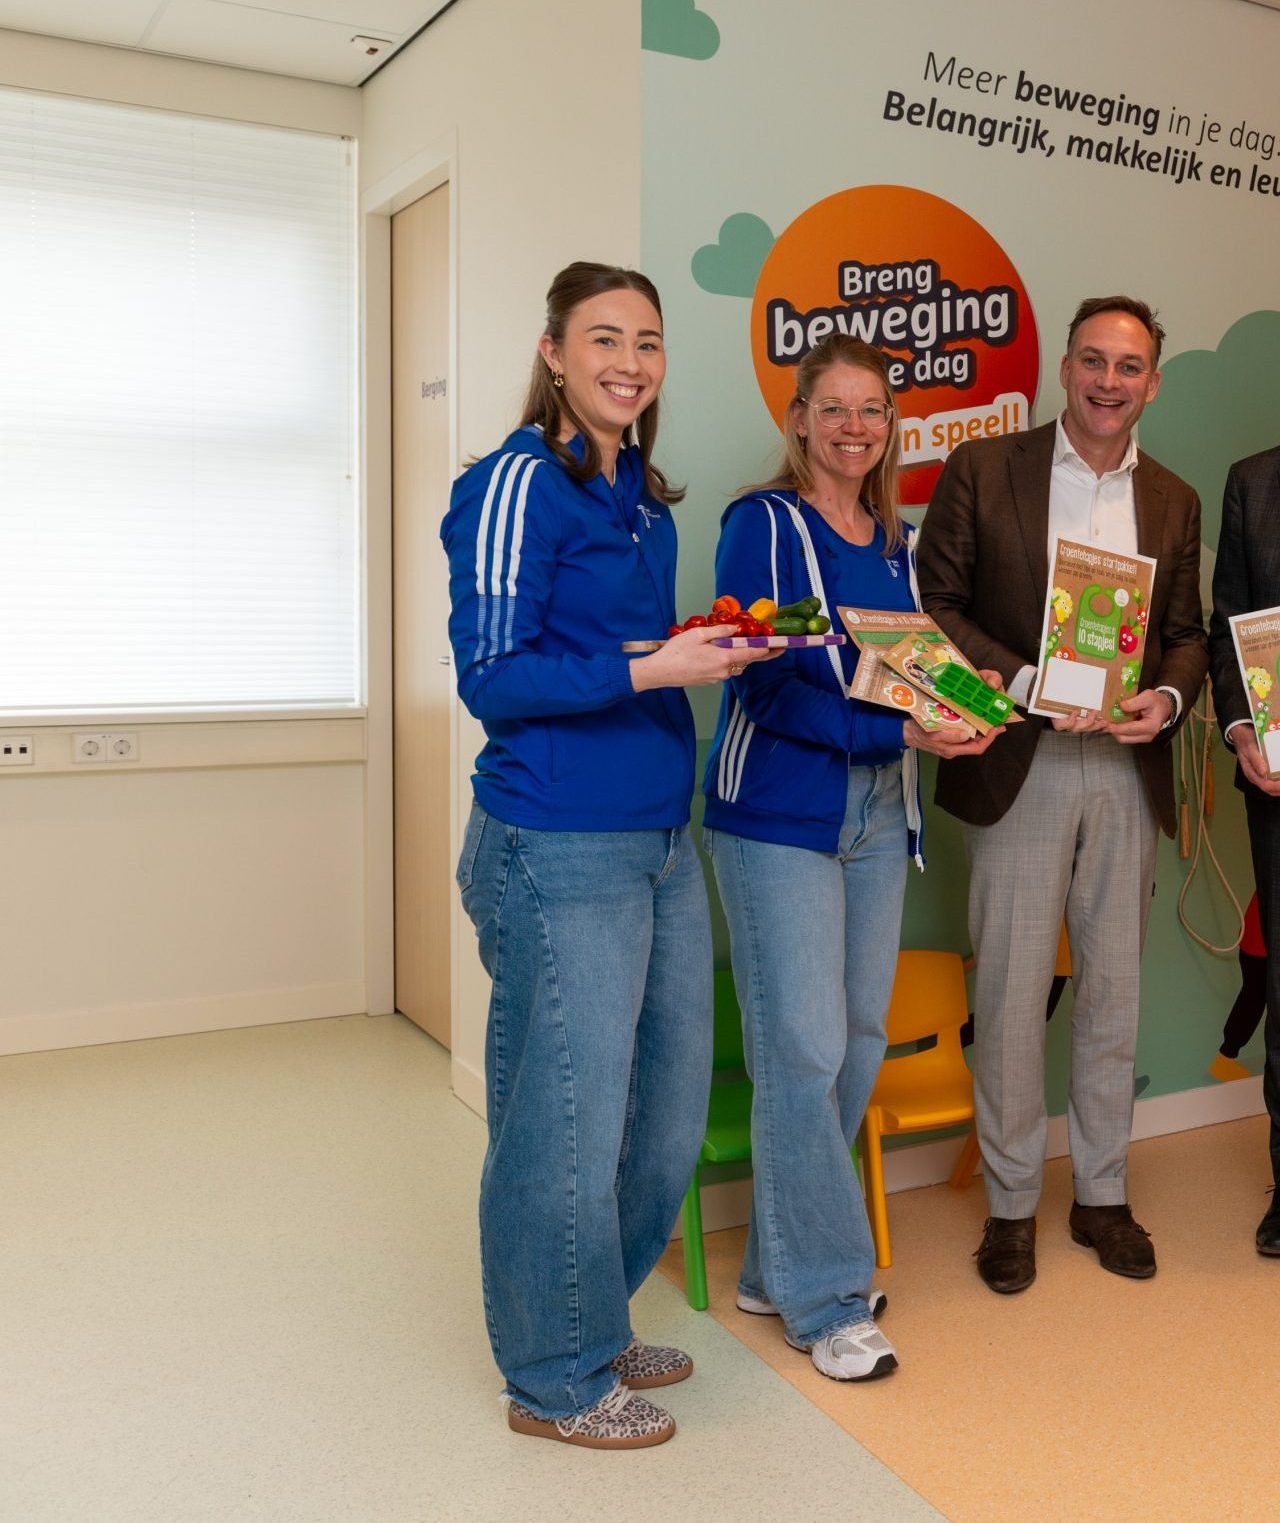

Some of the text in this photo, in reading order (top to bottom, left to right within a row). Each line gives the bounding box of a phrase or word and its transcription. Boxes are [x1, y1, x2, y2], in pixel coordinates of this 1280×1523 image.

[923, 51, 1008, 96] Meer
[1014, 70, 1161, 135] beweging
[1167, 106, 1191, 137] in
[1195, 113, 1222, 147] je
[883, 90, 1056, 158] Belangrijk,
[1066, 133, 1203, 184] makkelijk
[1209, 163, 1242, 189] en
[843, 263, 933, 296] Breng
[774, 287, 1009, 356] beweging
[421, 376, 447, 400] Berging
[888, 351, 969, 386] e dag
[931, 402, 1020, 452] speel!
